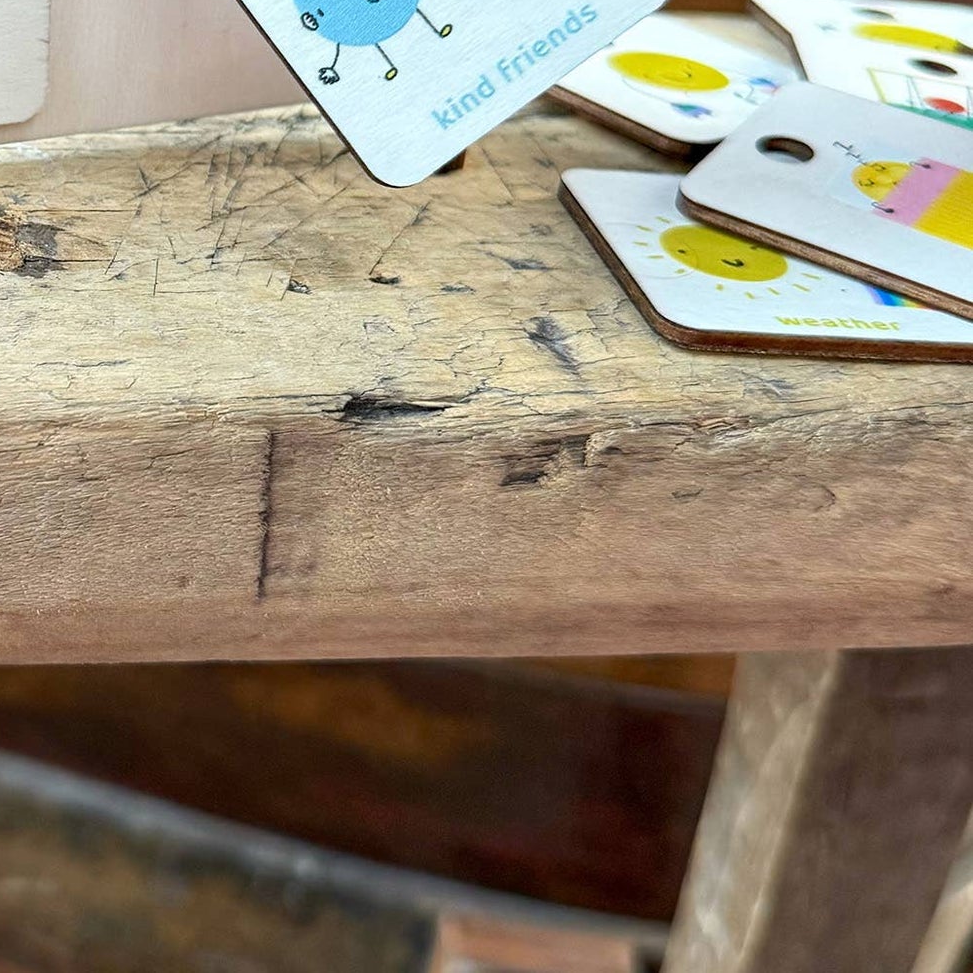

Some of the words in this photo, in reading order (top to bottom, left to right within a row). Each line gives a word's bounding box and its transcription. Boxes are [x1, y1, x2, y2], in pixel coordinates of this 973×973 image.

[431, 74, 496, 130] kind
[496, 4, 599, 83] friends
[773, 315, 901, 332] weather
